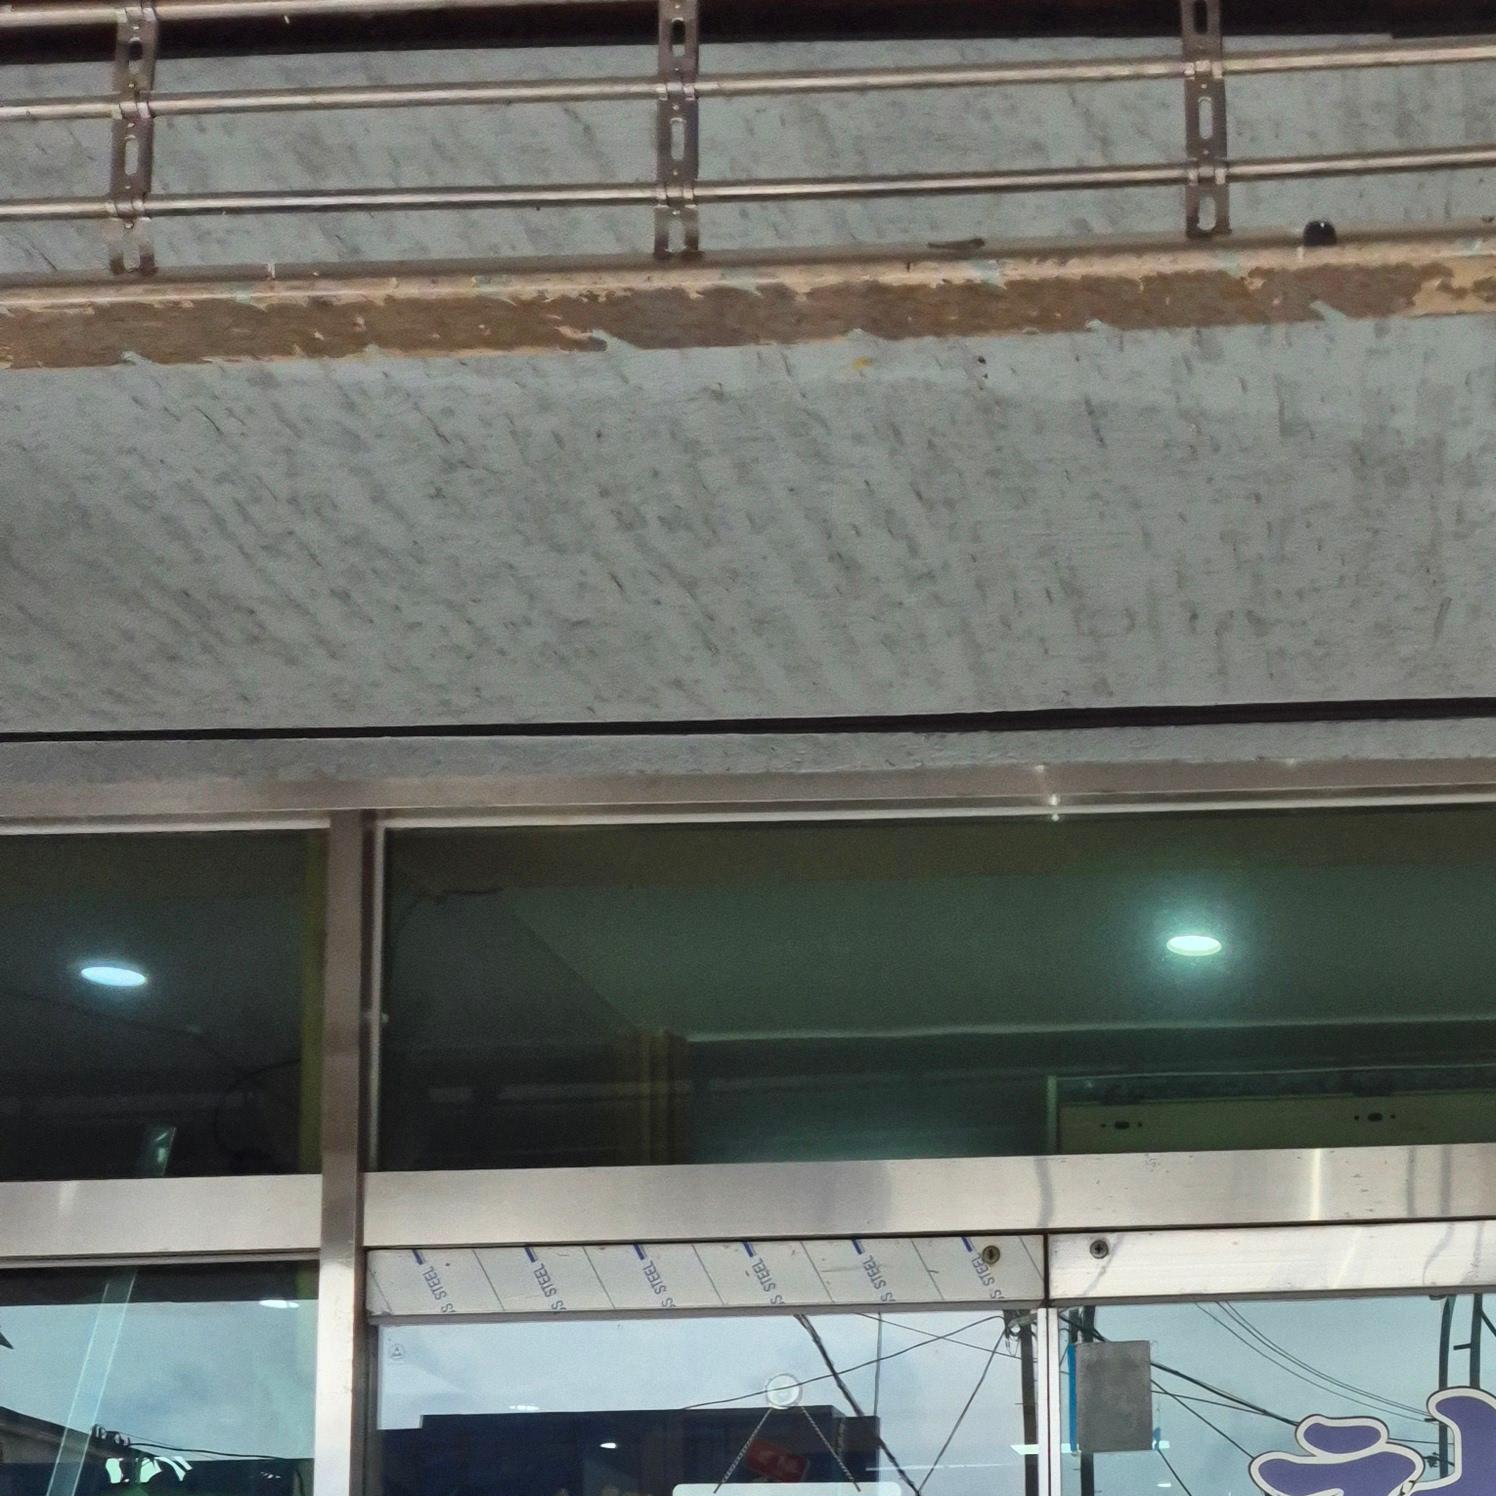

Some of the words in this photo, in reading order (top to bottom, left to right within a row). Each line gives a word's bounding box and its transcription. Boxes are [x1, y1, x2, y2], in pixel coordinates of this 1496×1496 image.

[423, 1265, 448, 1301] STEEL
[534, 1262, 558, 1298] STEEL
[643, 1259, 667, 1295] STEEL
[751, 1257, 776, 1292] STEEL
[862, 1254, 887, 1290] STEEL
